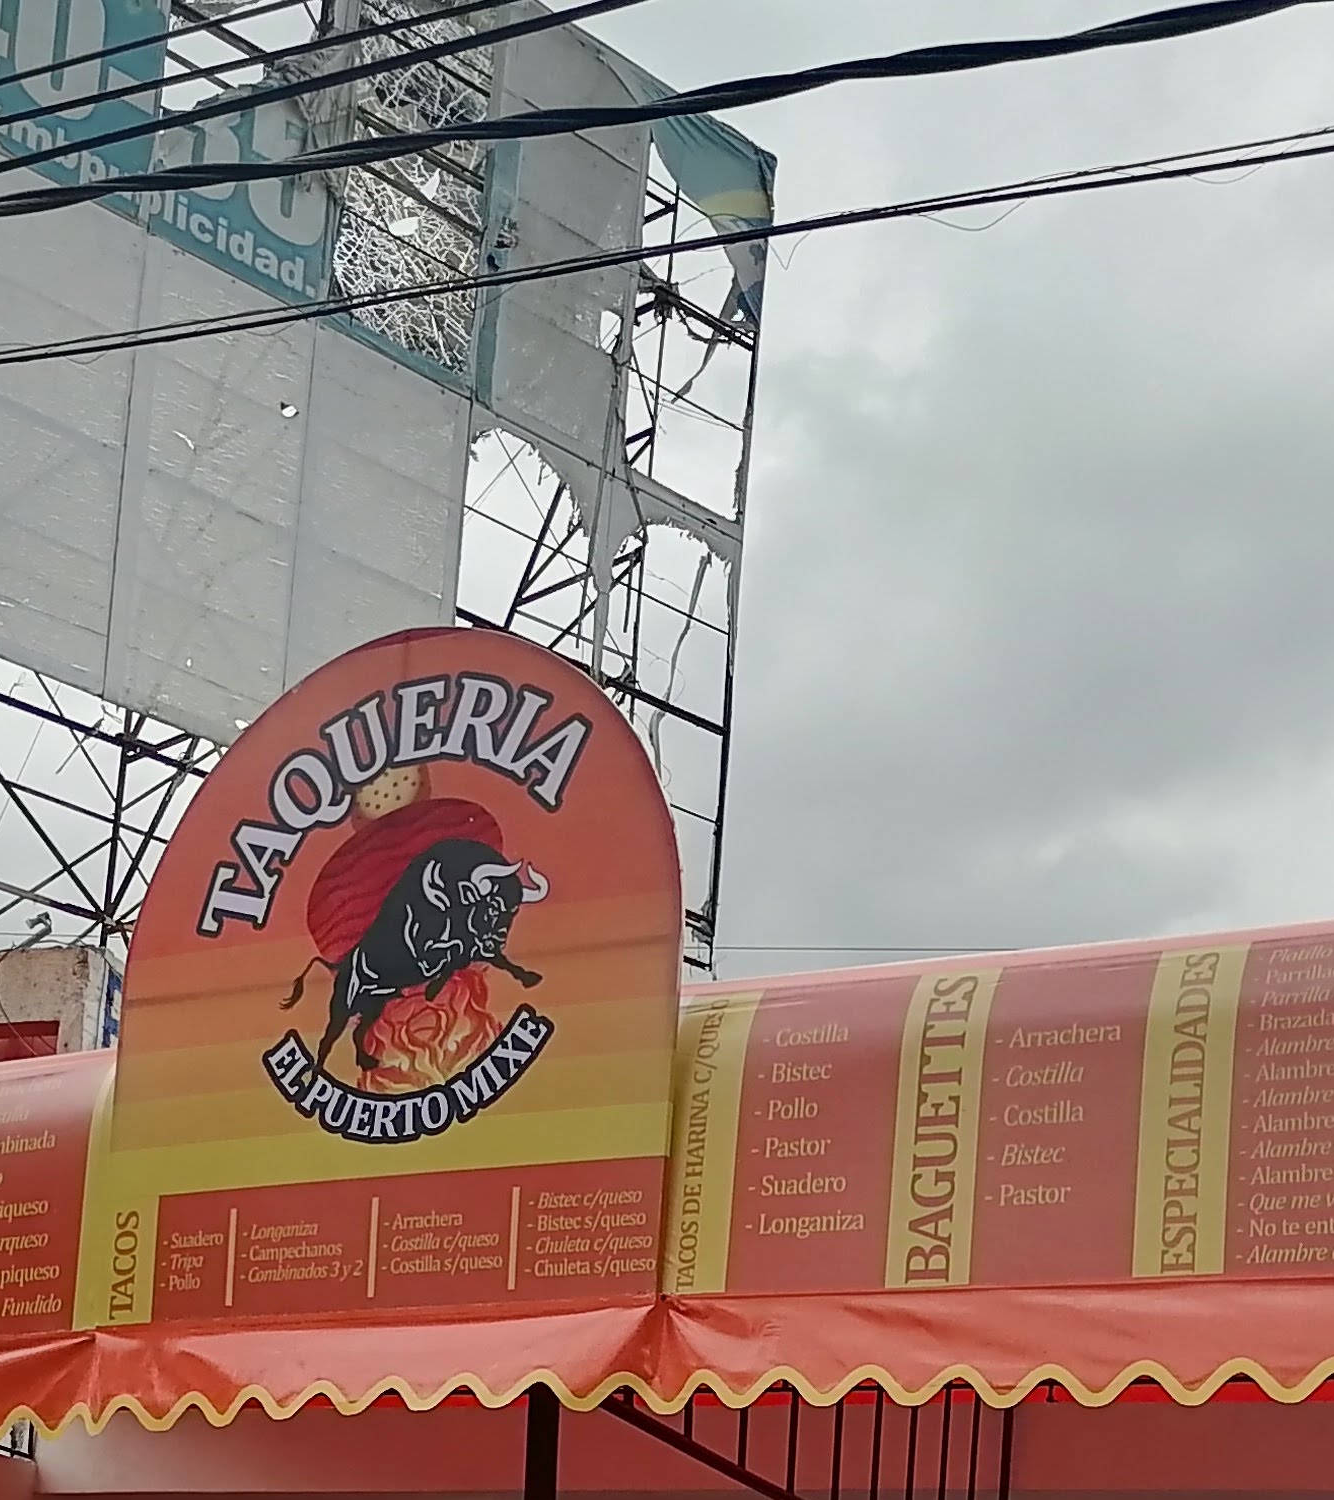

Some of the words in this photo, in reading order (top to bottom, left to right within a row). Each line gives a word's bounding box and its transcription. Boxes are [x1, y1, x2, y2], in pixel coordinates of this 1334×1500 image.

[202, 677, 591, 935] TAQUERIA
[776, 1023, 849, 1047] Costilla
[1010, 1023, 1121, 1049] Arrachera
[267, 1037, 312, 1096] EL
[301, 1078, 450, 1139] PUERTO
[456, 1009, 551, 1116] MIXE
[771, 1062, 832, 1084] Bistec
[1006, 1063, 1084, 1086] Costilla
[1253, 1086, 1333, 1108] Alambre
[768, 1099, 818, 1119] Pollo
[1003, 1103, 1084, 1126] Costilla
[1161, 951, 1220, 1273] ESPECIALIDADES
[685, 1100, 709, 1180] HARINA
[905, 976, 978, 1284] BAGUETTES
[764, 1135, 831, 1159] Pastor
[1001, 1144, 1066, 1166] Bistec
[1251, 1139, 1332, 1160] Alambre
[761, 1173, 847, 1196] Suadero
[1251, 1164, 1333, 1185] Alambre
[537, 1190, 580, 1210] Bistec
[582, 1187, 643, 1210] c/queso
[681, 1184, 702, 1216] DE
[1000, 1182, 1072, 1206] Pastor
[1249, 1192, 1286, 1211] Que
[1290, 1193, 1320, 1209] me
[249, 1219, 320, 1244] Longaniza
[392, 1212, 463, 1231] Arrachera
[536, 1213, 579, 1232] Bistec
[583, 1210, 647, 1232] s/queso
[759, 1210, 864, 1238] Longaniza
[1249, 1220, 1277, 1237] No
[170, 1230, 224, 1248] Suadero
[389, 1233, 441, 1253] Costilla
[443, 1230, 500, 1253] c/queso
[535, 1235, 591, 1255] Chuleta
[594, 1233, 653, 1254] c/queso
[169, 1252, 203, 1275] Tripa
[247, 1240, 343, 1266] Campechanos
[389, 1255, 442, 1276] Costilla
[445, 1252, 503, 1274] s/queso
[675, 1224, 699, 1292] TACOS
[1246, 1243, 1327, 1264] Alambre
[108, 1210, 140, 1320] TACOS
[534, 1258, 591, 1278] Chuleta
[593, 1256, 658, 1278] s/queso
[168, 1273, 201, 1292] Pollo
[1, 1295, 62, 1319] Fundido
